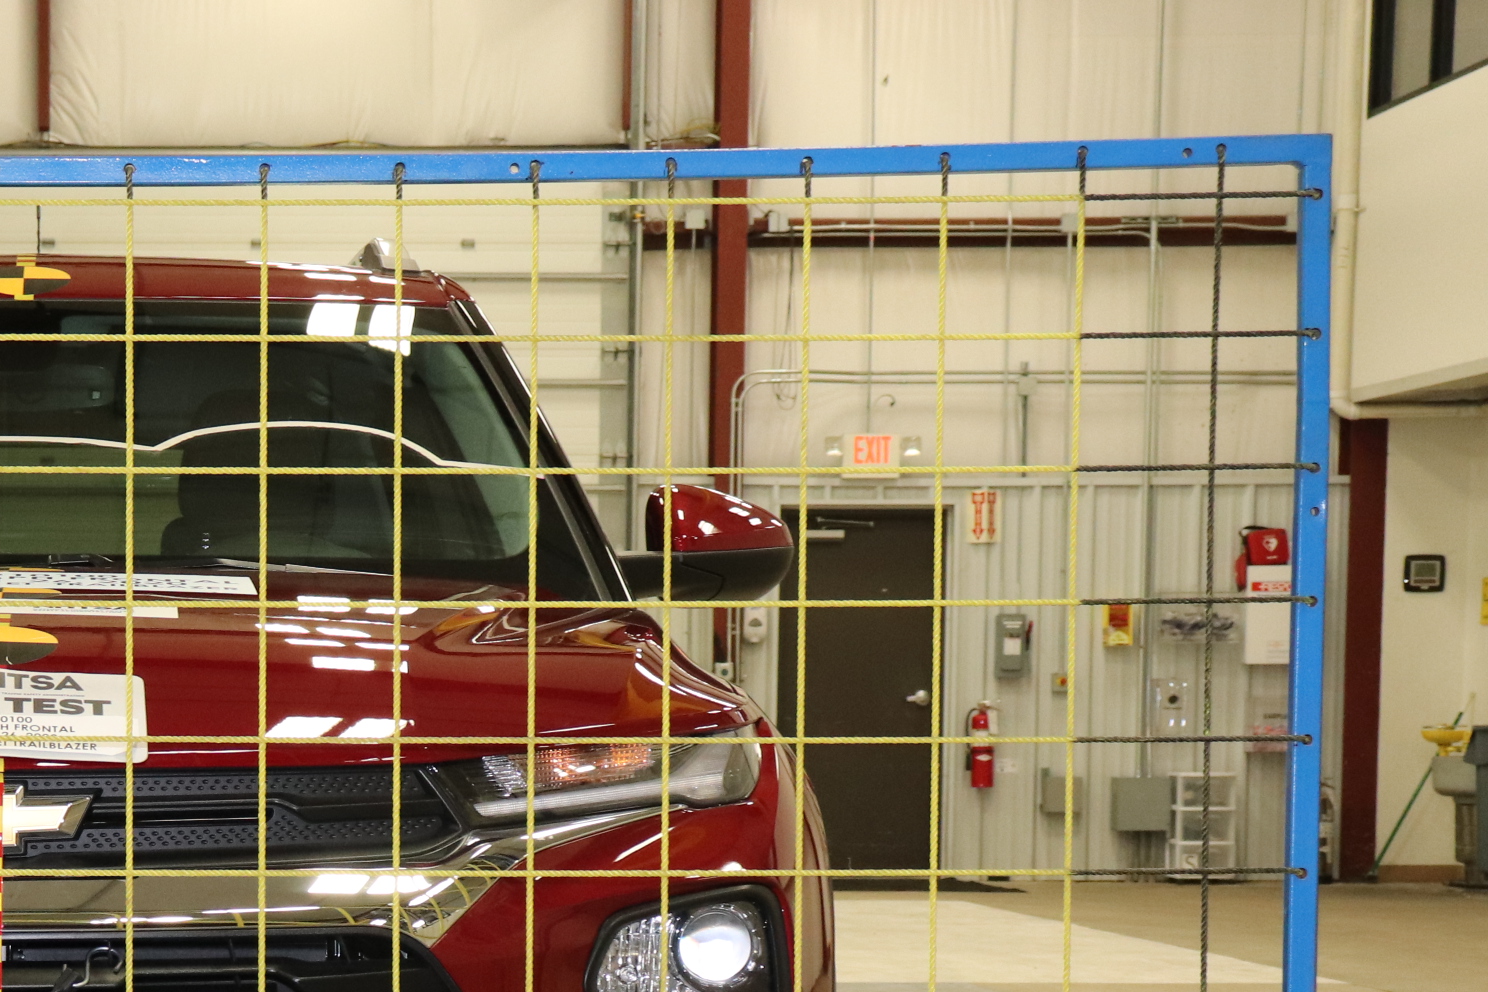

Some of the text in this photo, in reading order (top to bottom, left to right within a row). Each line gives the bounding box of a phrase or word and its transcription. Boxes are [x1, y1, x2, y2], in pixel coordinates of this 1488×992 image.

[854, 436, 892, 464] EXIT
[4, 697, 112, 716] TEST
[15, 723, 75, 733] FRONTAL
